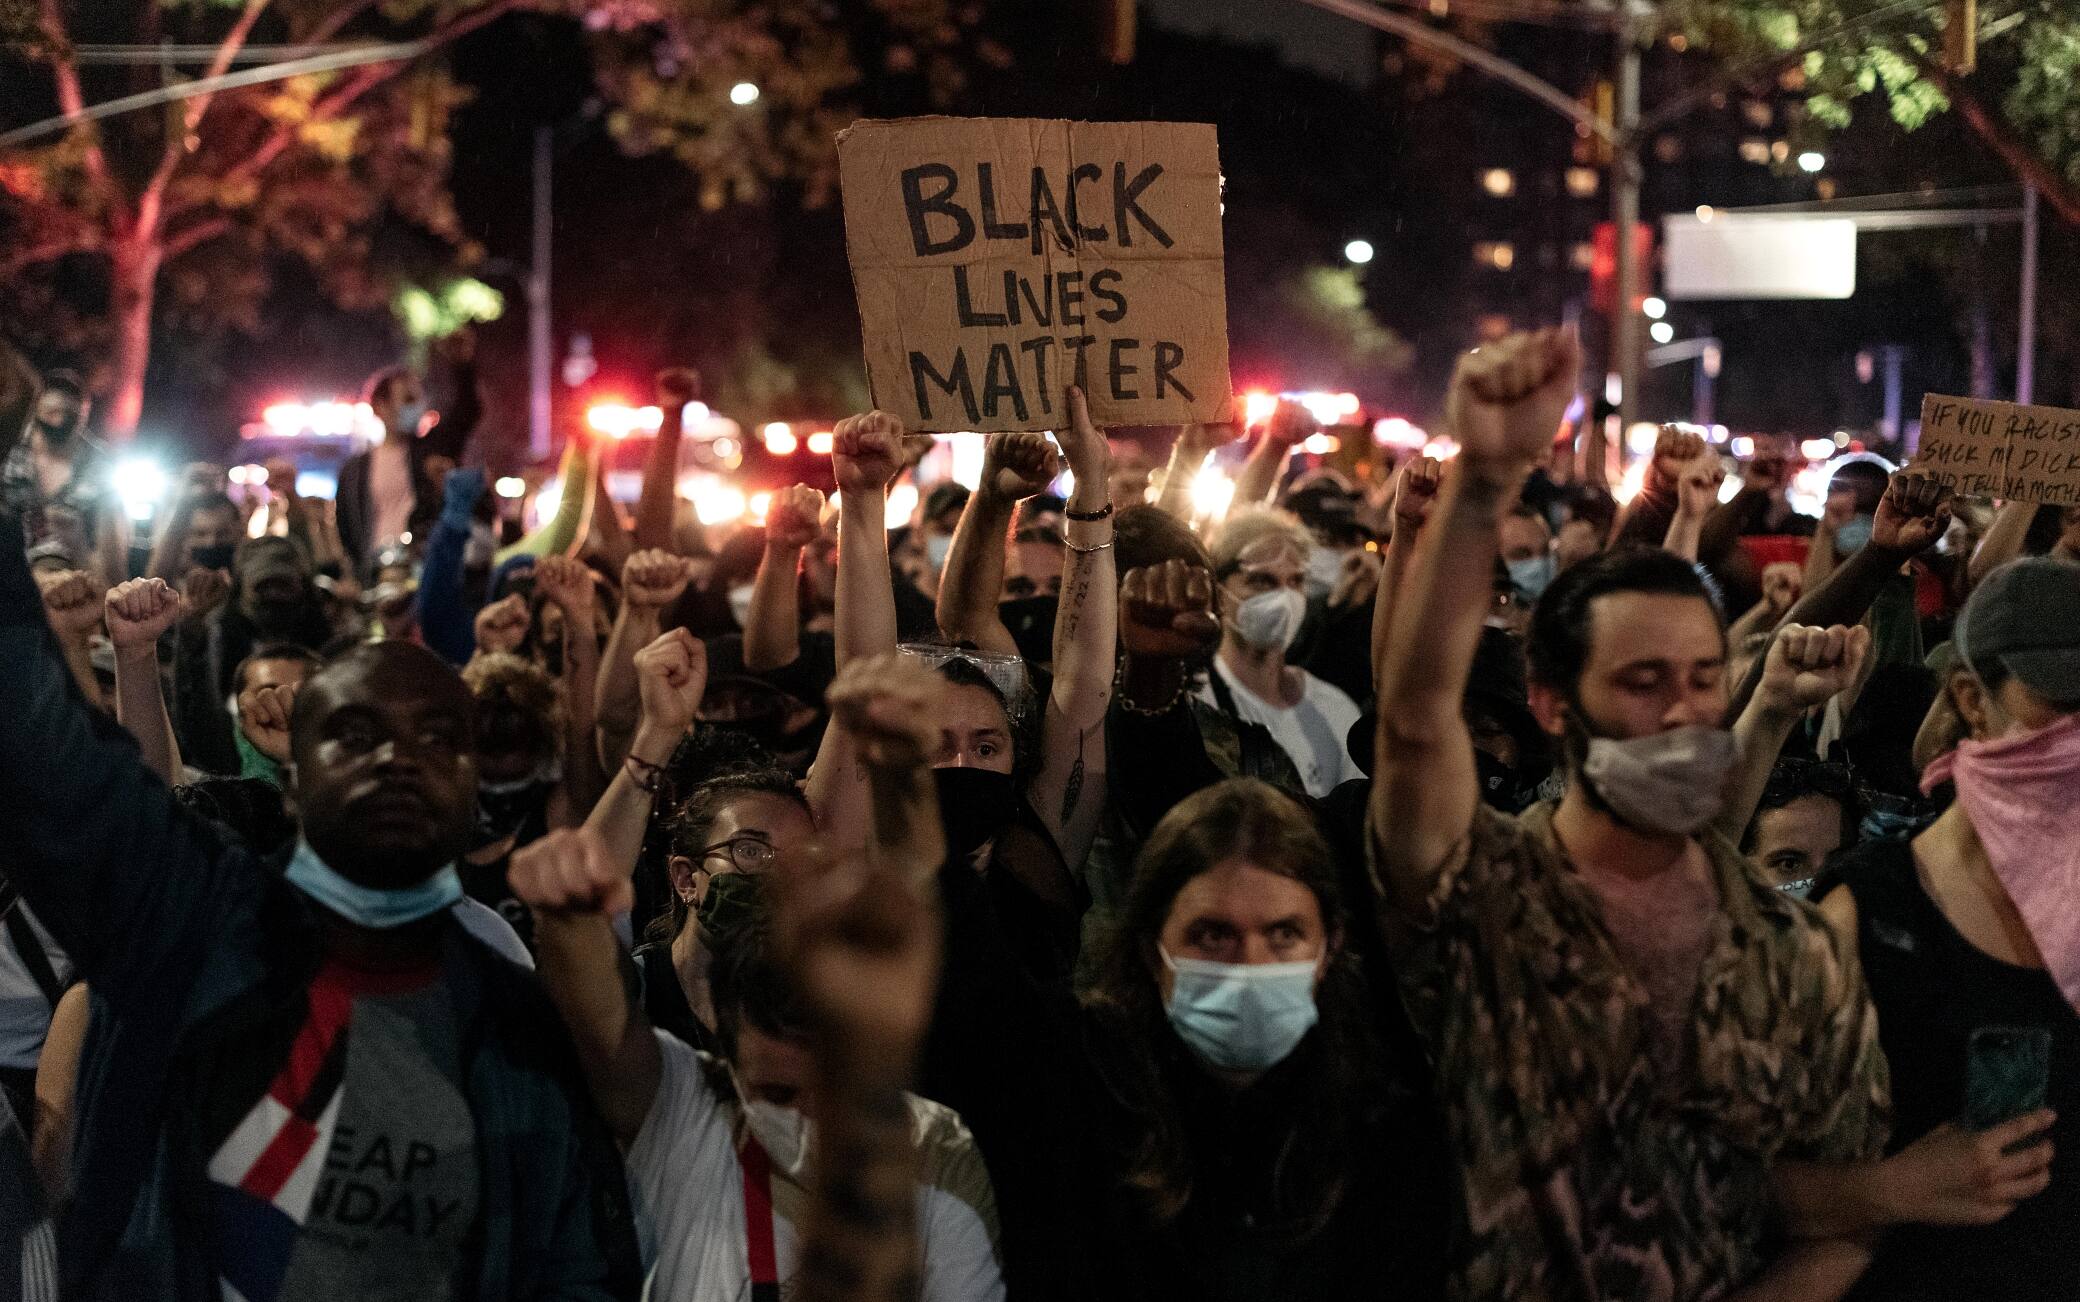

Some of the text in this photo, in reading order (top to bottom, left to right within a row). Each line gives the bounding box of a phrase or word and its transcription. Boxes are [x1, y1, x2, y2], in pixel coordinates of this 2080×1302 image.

[901, 161, 1175, 257] BLACK
[953, 264, 1128, 328] LIVES
[908, 336, 1196, 425] MATTER
[1922, 439, 1979, 464] SUCK
[1931, 403, 1957, 427] IF
[1957, 406, 1995, 437] YOU
